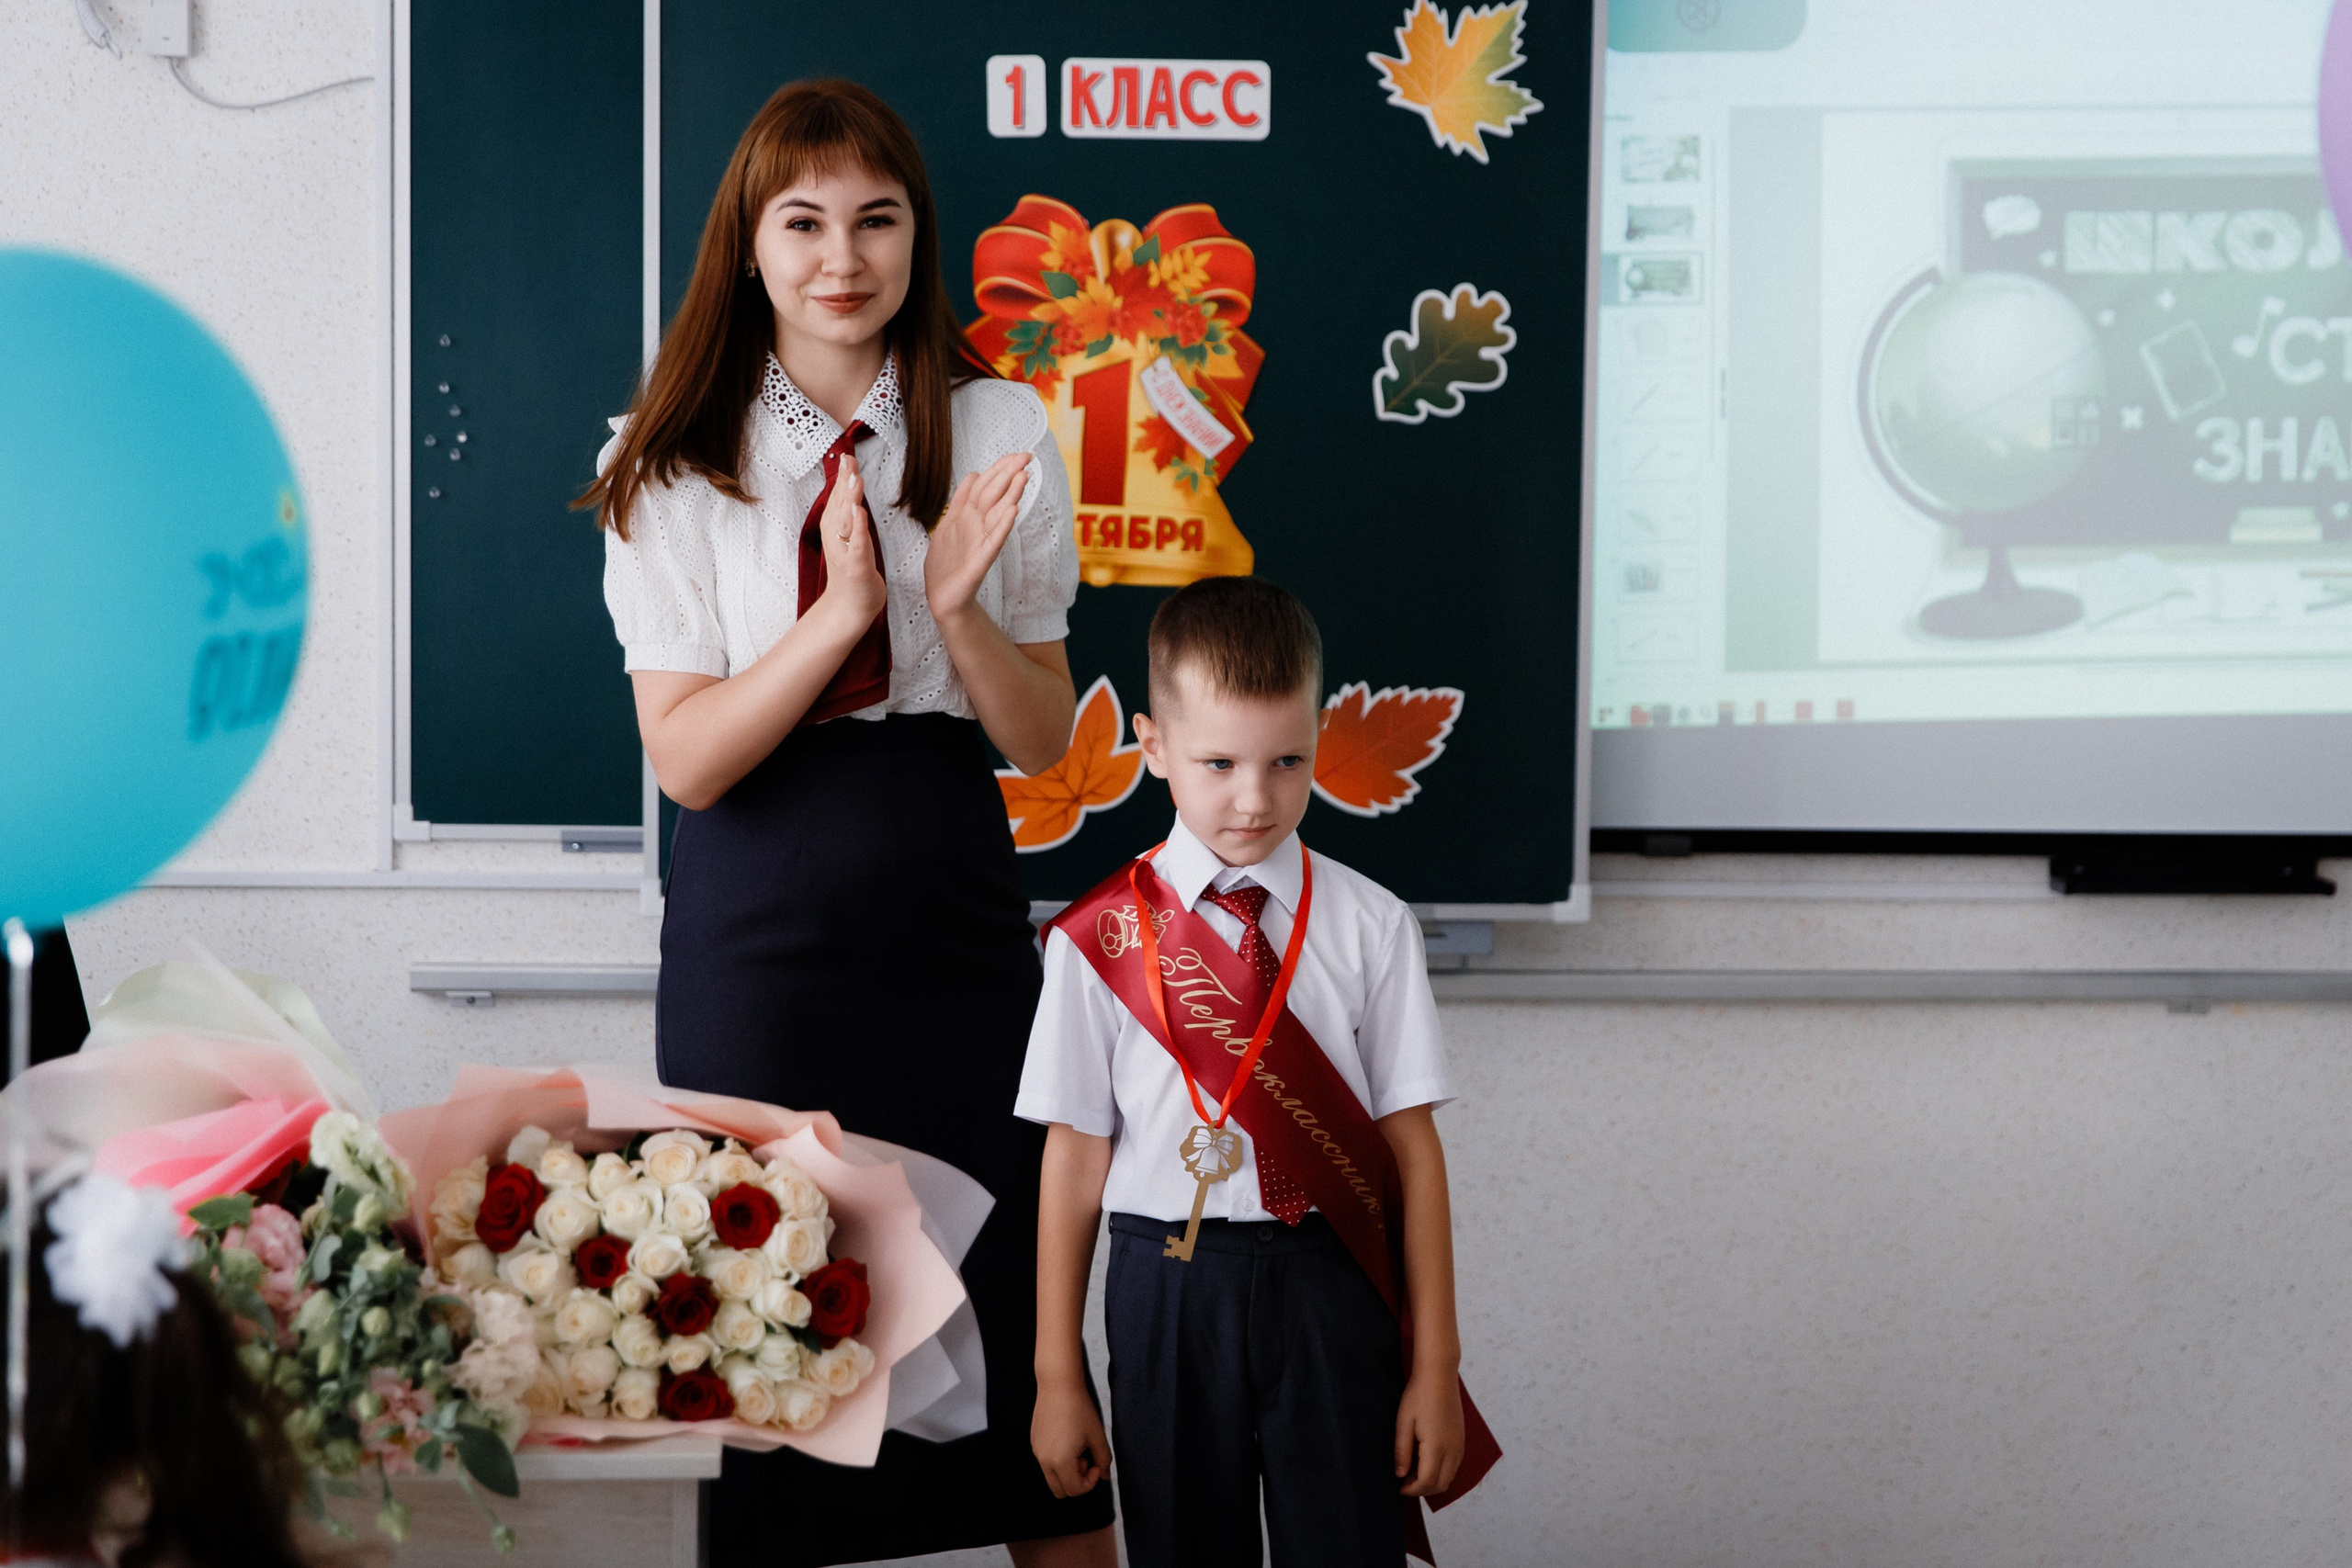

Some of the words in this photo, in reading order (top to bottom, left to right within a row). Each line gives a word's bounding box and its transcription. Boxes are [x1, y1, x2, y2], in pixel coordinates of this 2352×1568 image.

[1005, 64, 1024, 128] 1
[1070, 64, 1263, 129] КЛАСС
[1072, 358, 1131, 506] 1
[1077, 513, 1204, 552] ТЯБРЯ
